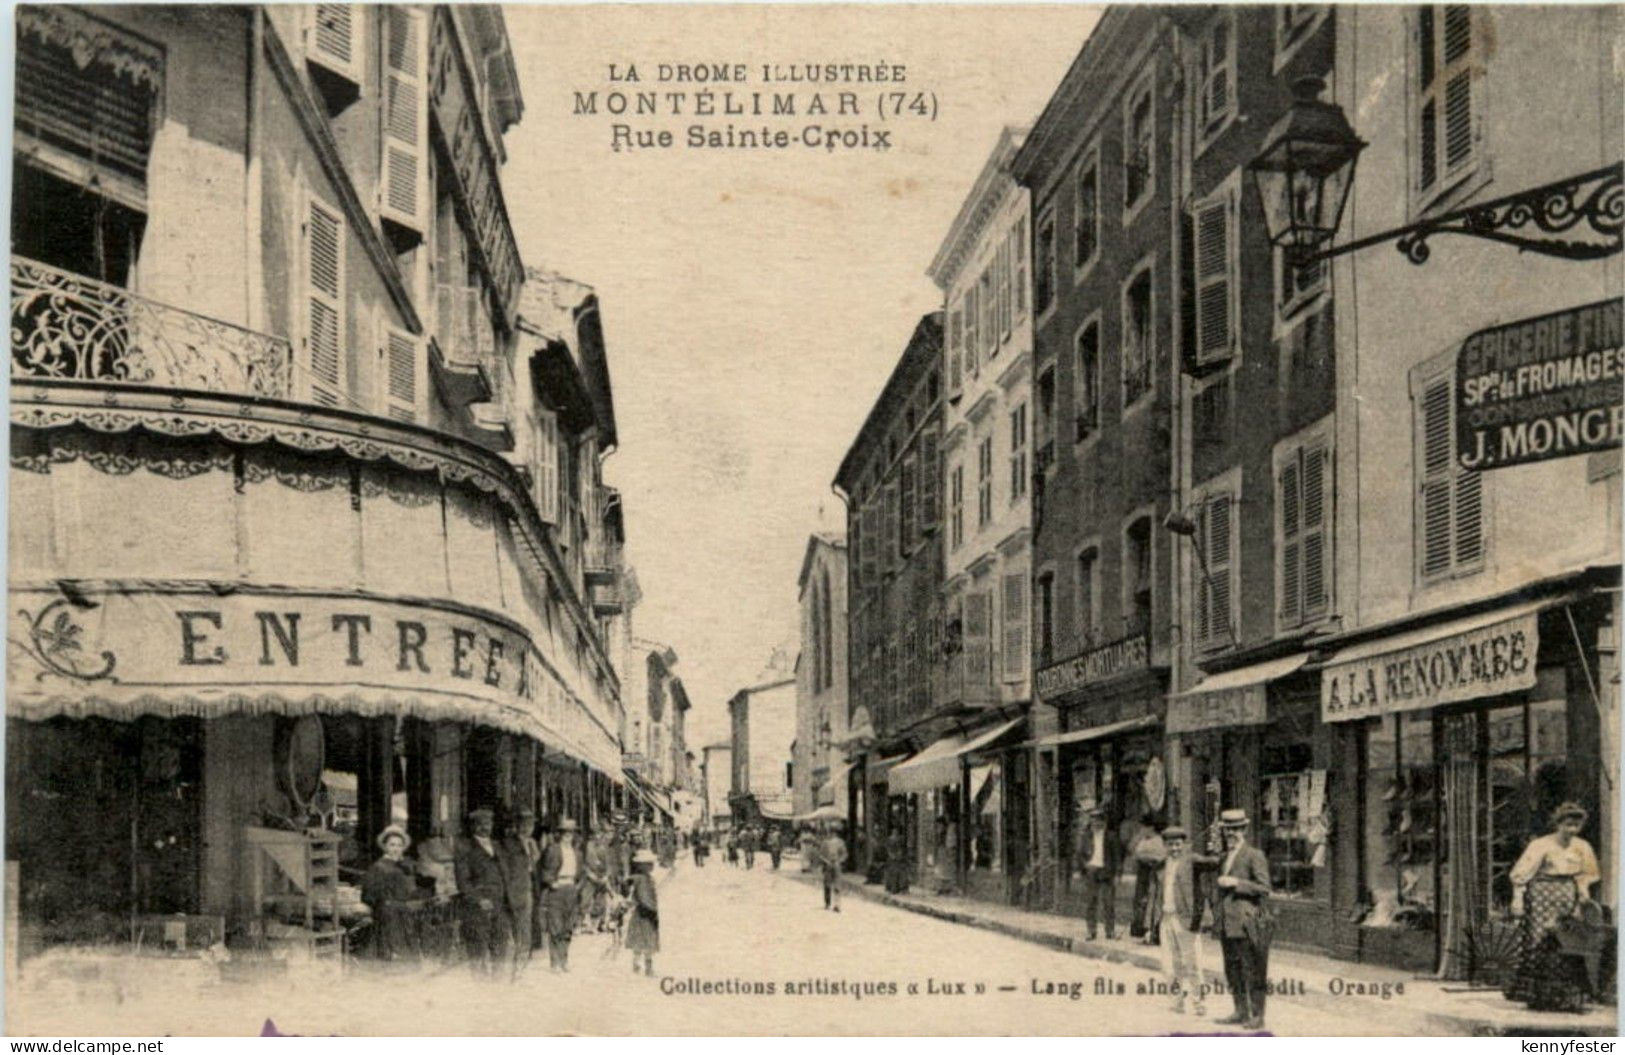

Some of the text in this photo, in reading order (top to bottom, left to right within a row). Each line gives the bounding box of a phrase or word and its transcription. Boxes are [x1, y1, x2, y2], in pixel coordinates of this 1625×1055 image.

[1463, 311, 1574, 376] EPICERIE
[1516, 346, 1624, 396] FROMAGES
[1460, 430, 1496, 469] J.
[176, 610, 505, 686] ENTREE
[1327, 674, 1344, 714] A
[1348, 667, 1379, 707] LA
